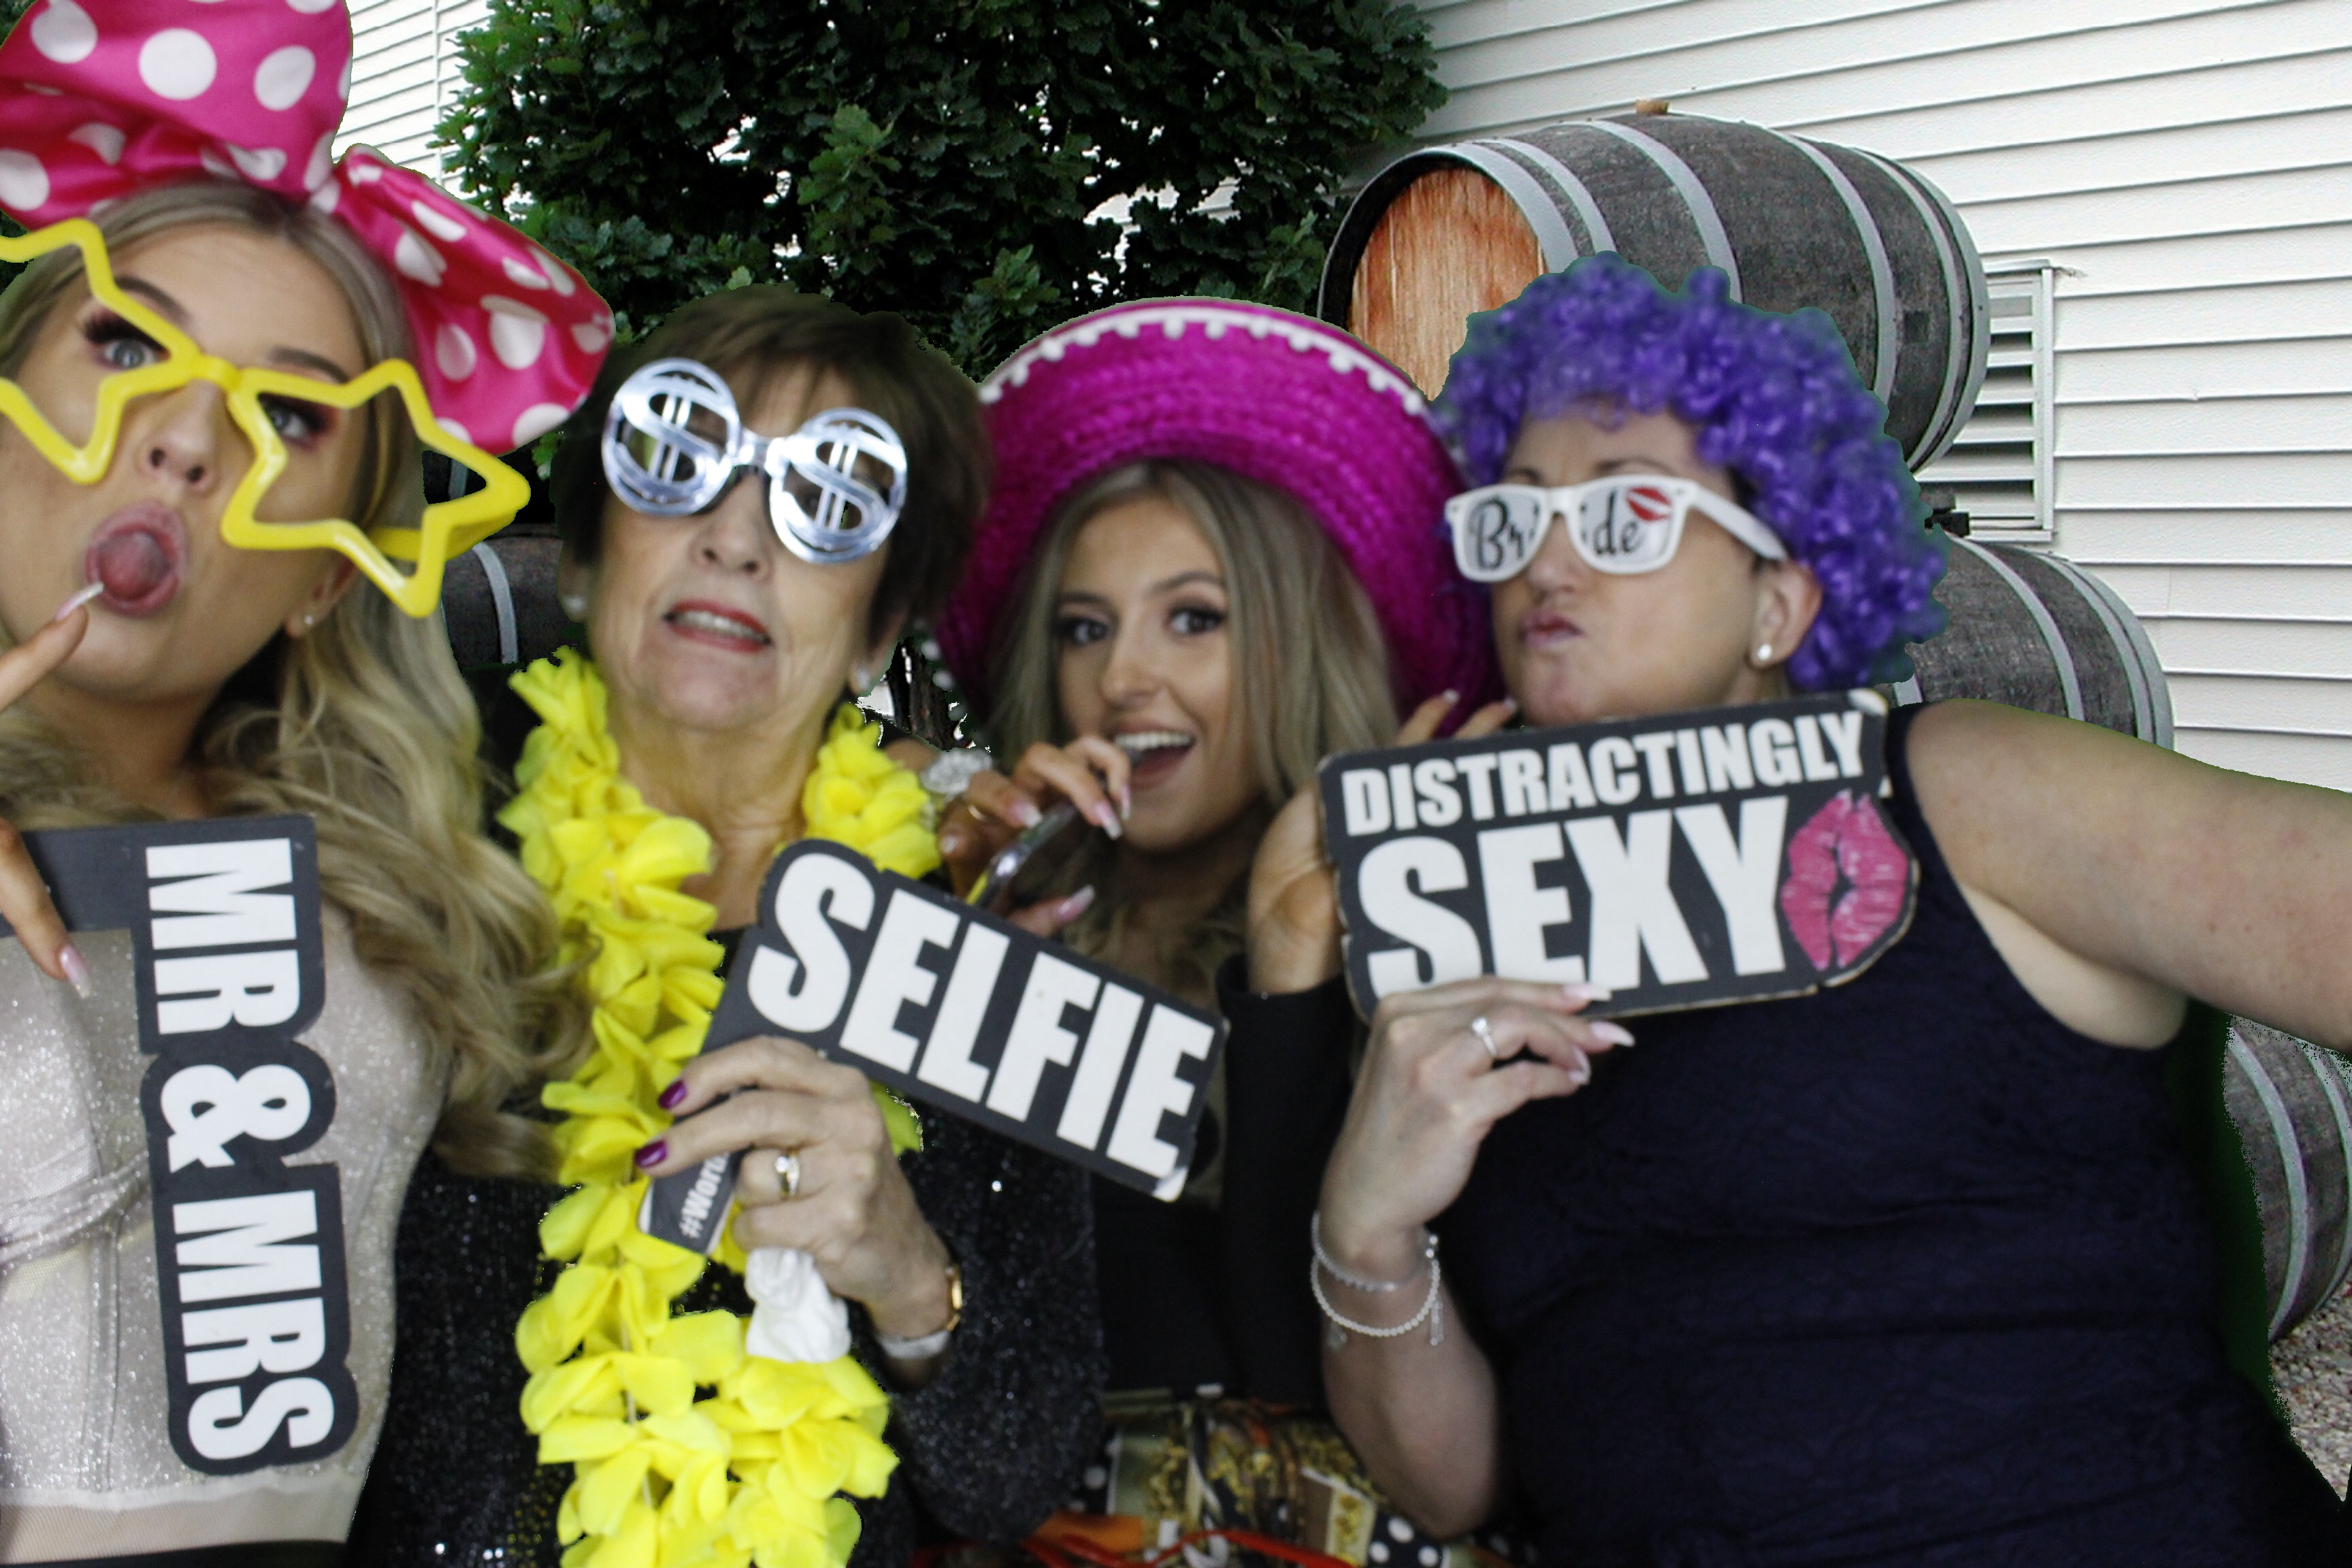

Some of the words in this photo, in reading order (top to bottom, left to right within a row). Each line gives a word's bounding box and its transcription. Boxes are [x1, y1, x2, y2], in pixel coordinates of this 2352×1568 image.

[1341, 710, 1864, 836] DISTRACTINGLY
[145, 838, 300, 1035] MR
[1358, 795, 1788, 1003] SEXY
[747, 853, 1215, 1178] SELFIE
[160, 1064, 311, 1173] &
[172, 1190, 334, 1460] MRS
